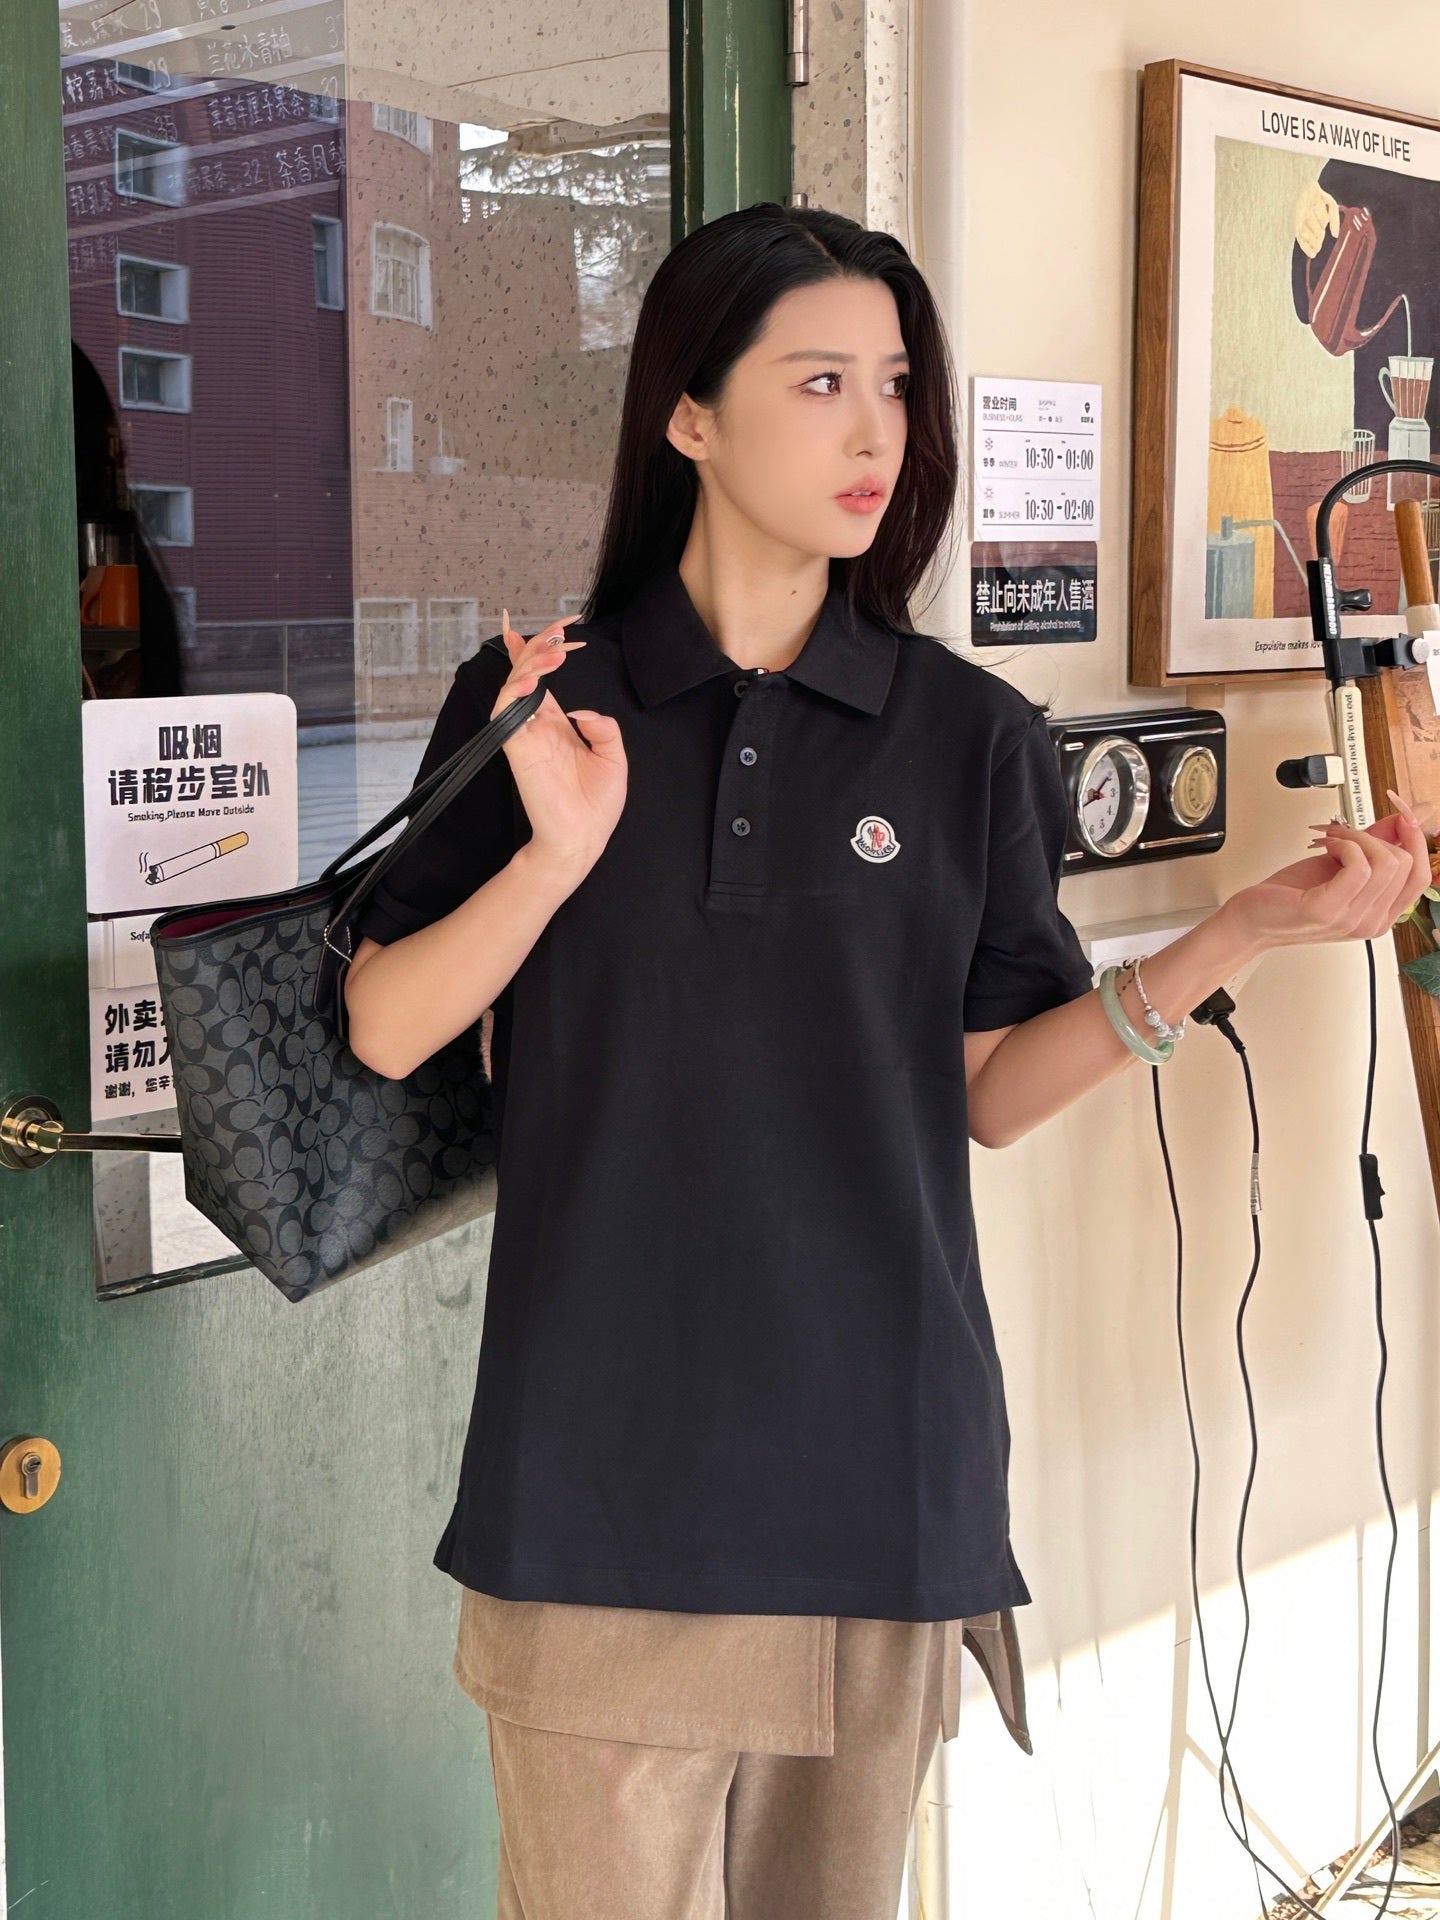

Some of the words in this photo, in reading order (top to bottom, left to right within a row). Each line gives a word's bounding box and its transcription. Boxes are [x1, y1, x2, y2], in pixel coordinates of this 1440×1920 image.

[1261, 109, 1299, 139] LOVE
[1302, 118, 1315, 141] IS
[1318, 122, 1329, 144] A
[1330, 123, 1360, 150] WAY
[1362, 131, 1380, 153] OF
[1382, 135, 1411, 162] LIFE
[983, 396, 1017, 411] 营业时间
[1026, 447, 1054, 469] 10:30
[1066, 449, 1094, 470] 01:00
[1026, 499, 1054, 520] 10:30
[1064, 499, 1094, 520] 02:00
[976, 578, 1095, 615] 禁止向未成年人售酒
[1288, 640, 1309, 650] makes
[1346, 712, 1353, 723] to
[158, 724, 222, 761] 吸烟
[1348, 743, 1357, 761] not
[1350, 763, 1359, 776] do
[107, 762, 270, 806] 请移步室外
[1352, 777, 1361, 794] but
[198, 807, 221, 817] Move
[223, 805, 255, 816] Outside
[105, 1000, 165, 1036] 外卖
